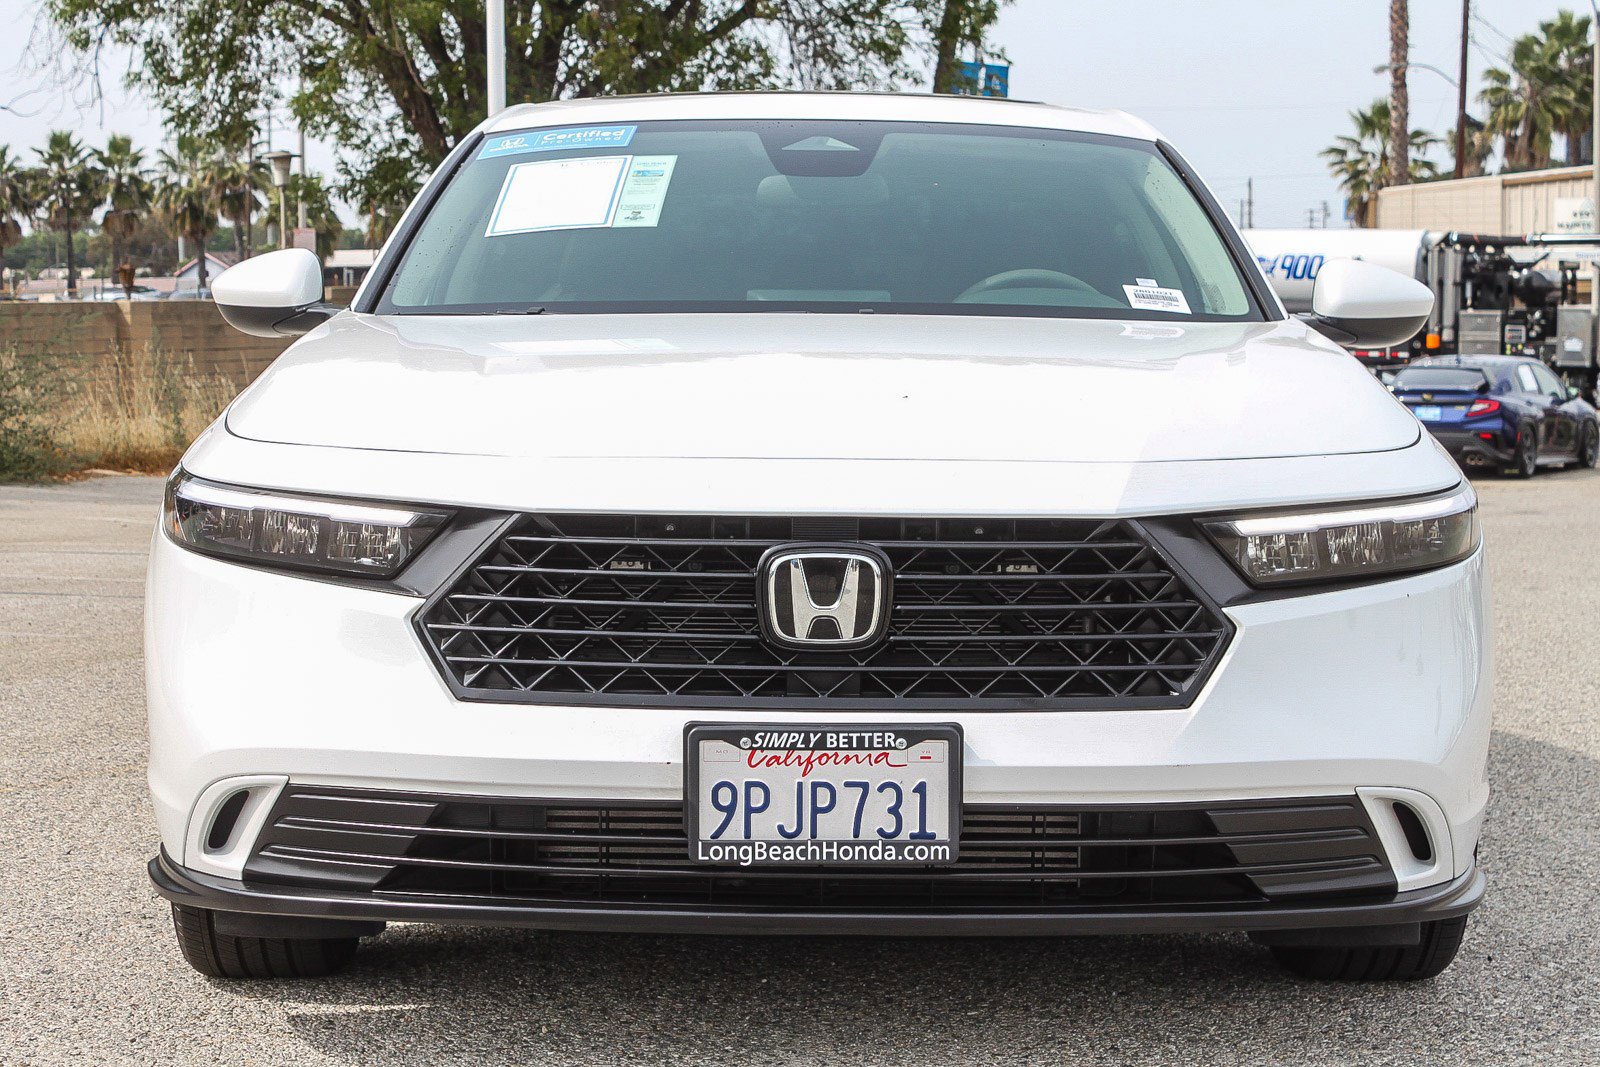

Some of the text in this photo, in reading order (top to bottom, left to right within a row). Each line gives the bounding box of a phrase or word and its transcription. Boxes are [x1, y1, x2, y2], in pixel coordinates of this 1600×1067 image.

[544, 129, 625, 141] Certified
[752, 732, 896, 748] SIMPLY BETTER
[747, 749, 908, 777] California
[709, 780, 938, 840] 9PJP731
[697, 840, 950, 866] LongBeachHonda.com
